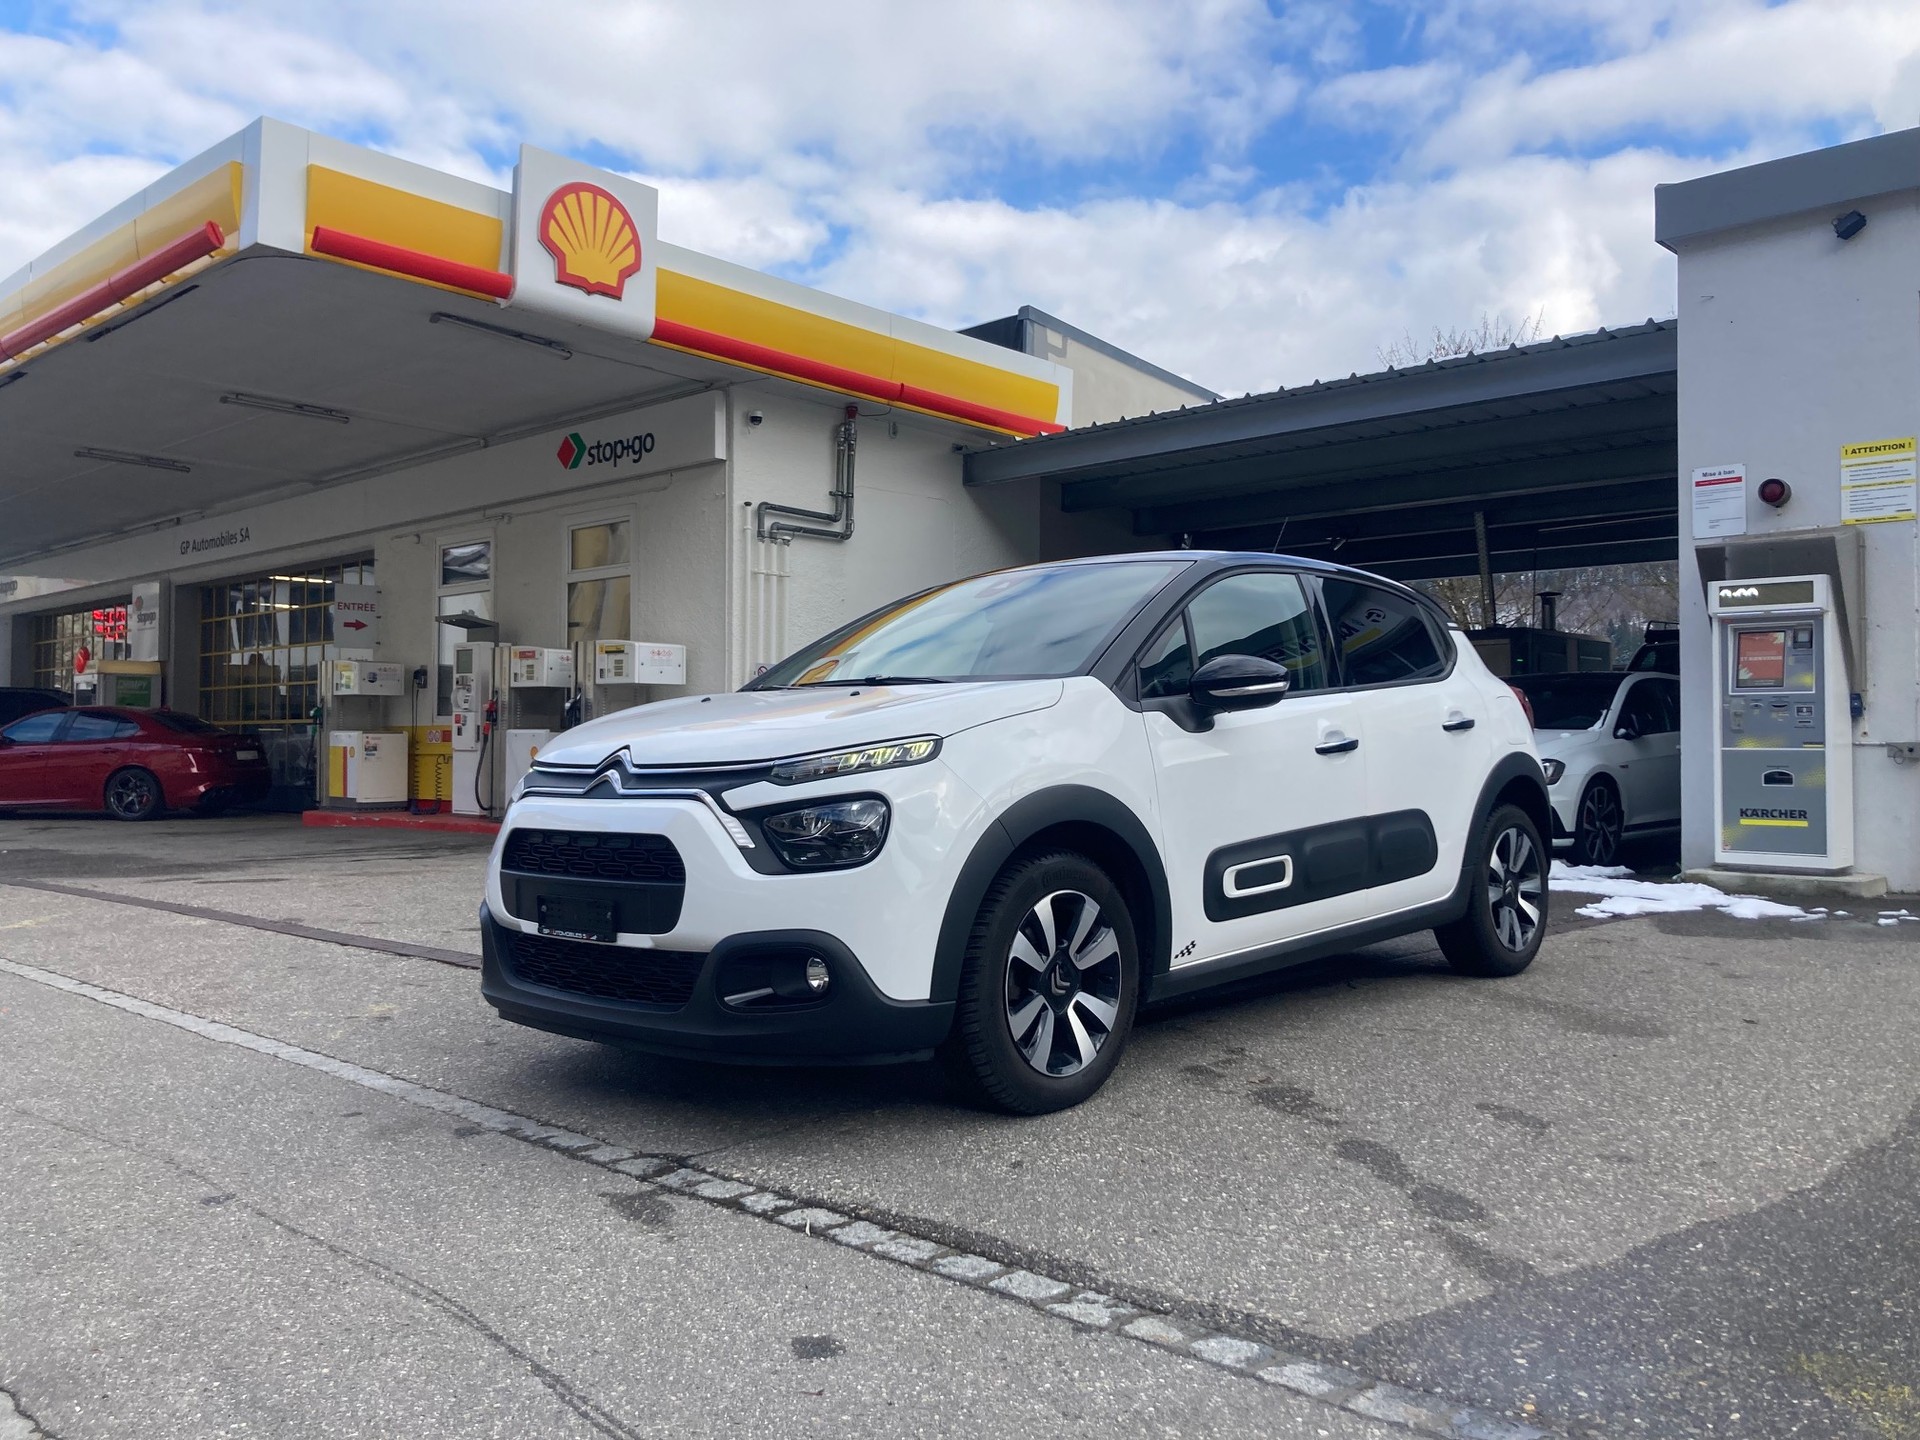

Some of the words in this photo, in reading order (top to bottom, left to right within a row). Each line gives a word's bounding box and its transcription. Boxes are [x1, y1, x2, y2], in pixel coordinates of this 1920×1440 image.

[587, 432, 655, 468] stop+go
[1850, 442, 1906, 455] ATTENTION
[180, 540, 191, 555] GP
[191, 530, 238, 553] Automobiles
[239, 526, 251, 543] SA
[337, 601, 376, 612] ENTRÉE
[1739, 808, 1808, 819] KÄRCHER
